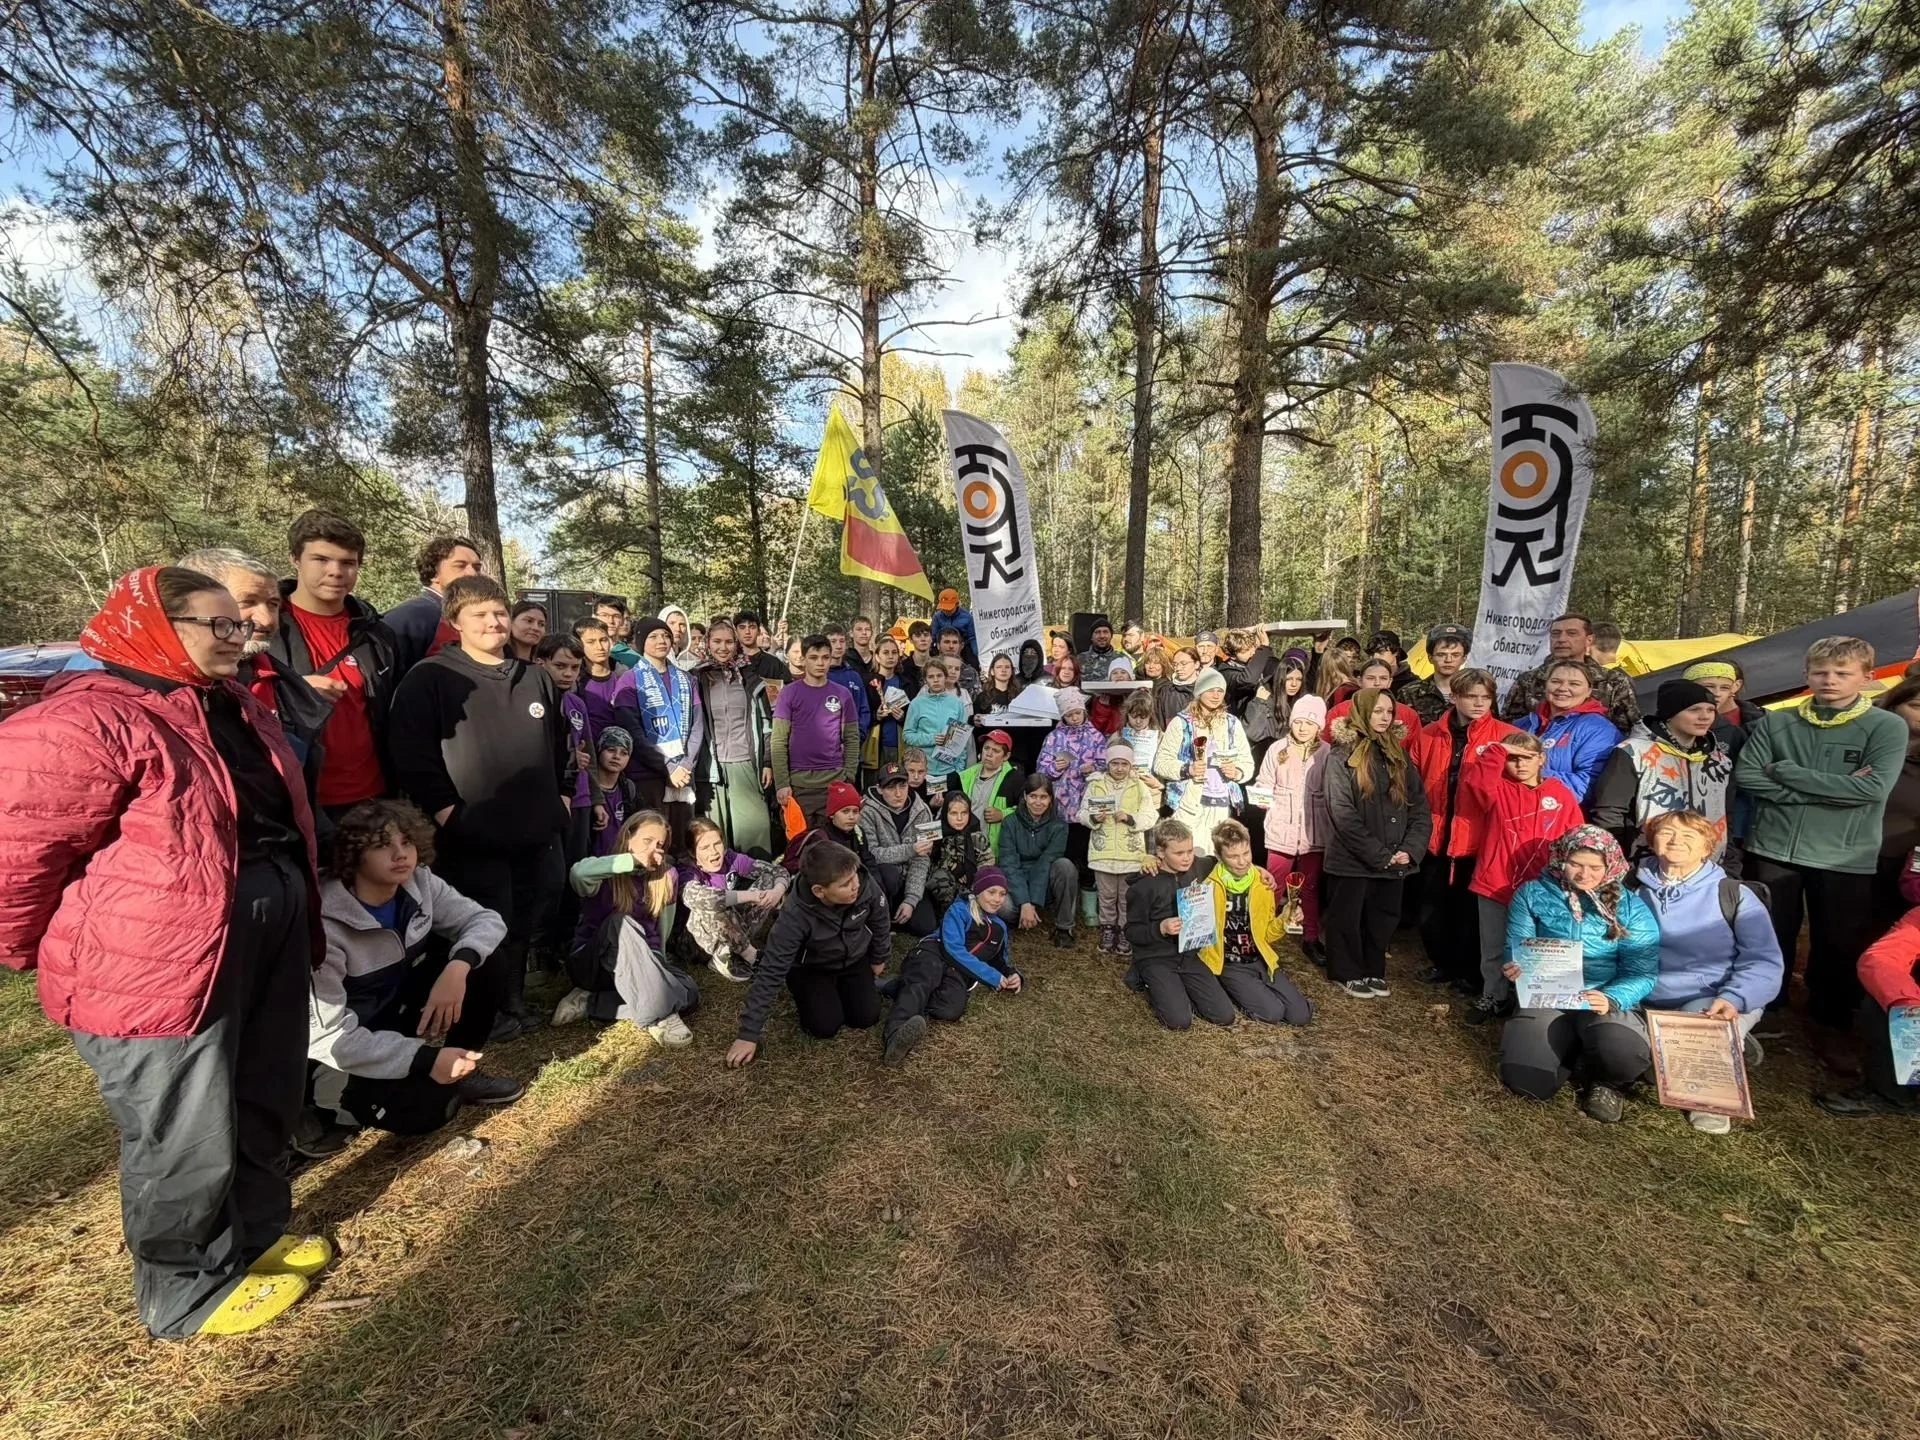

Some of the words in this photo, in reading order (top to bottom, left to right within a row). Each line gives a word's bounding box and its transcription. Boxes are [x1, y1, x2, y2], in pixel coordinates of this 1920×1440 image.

[978, 600, 1037, 621] Нижегородский
[990, 621, 1029, 640] областной
[1493, 636, 1542, 656] областной
